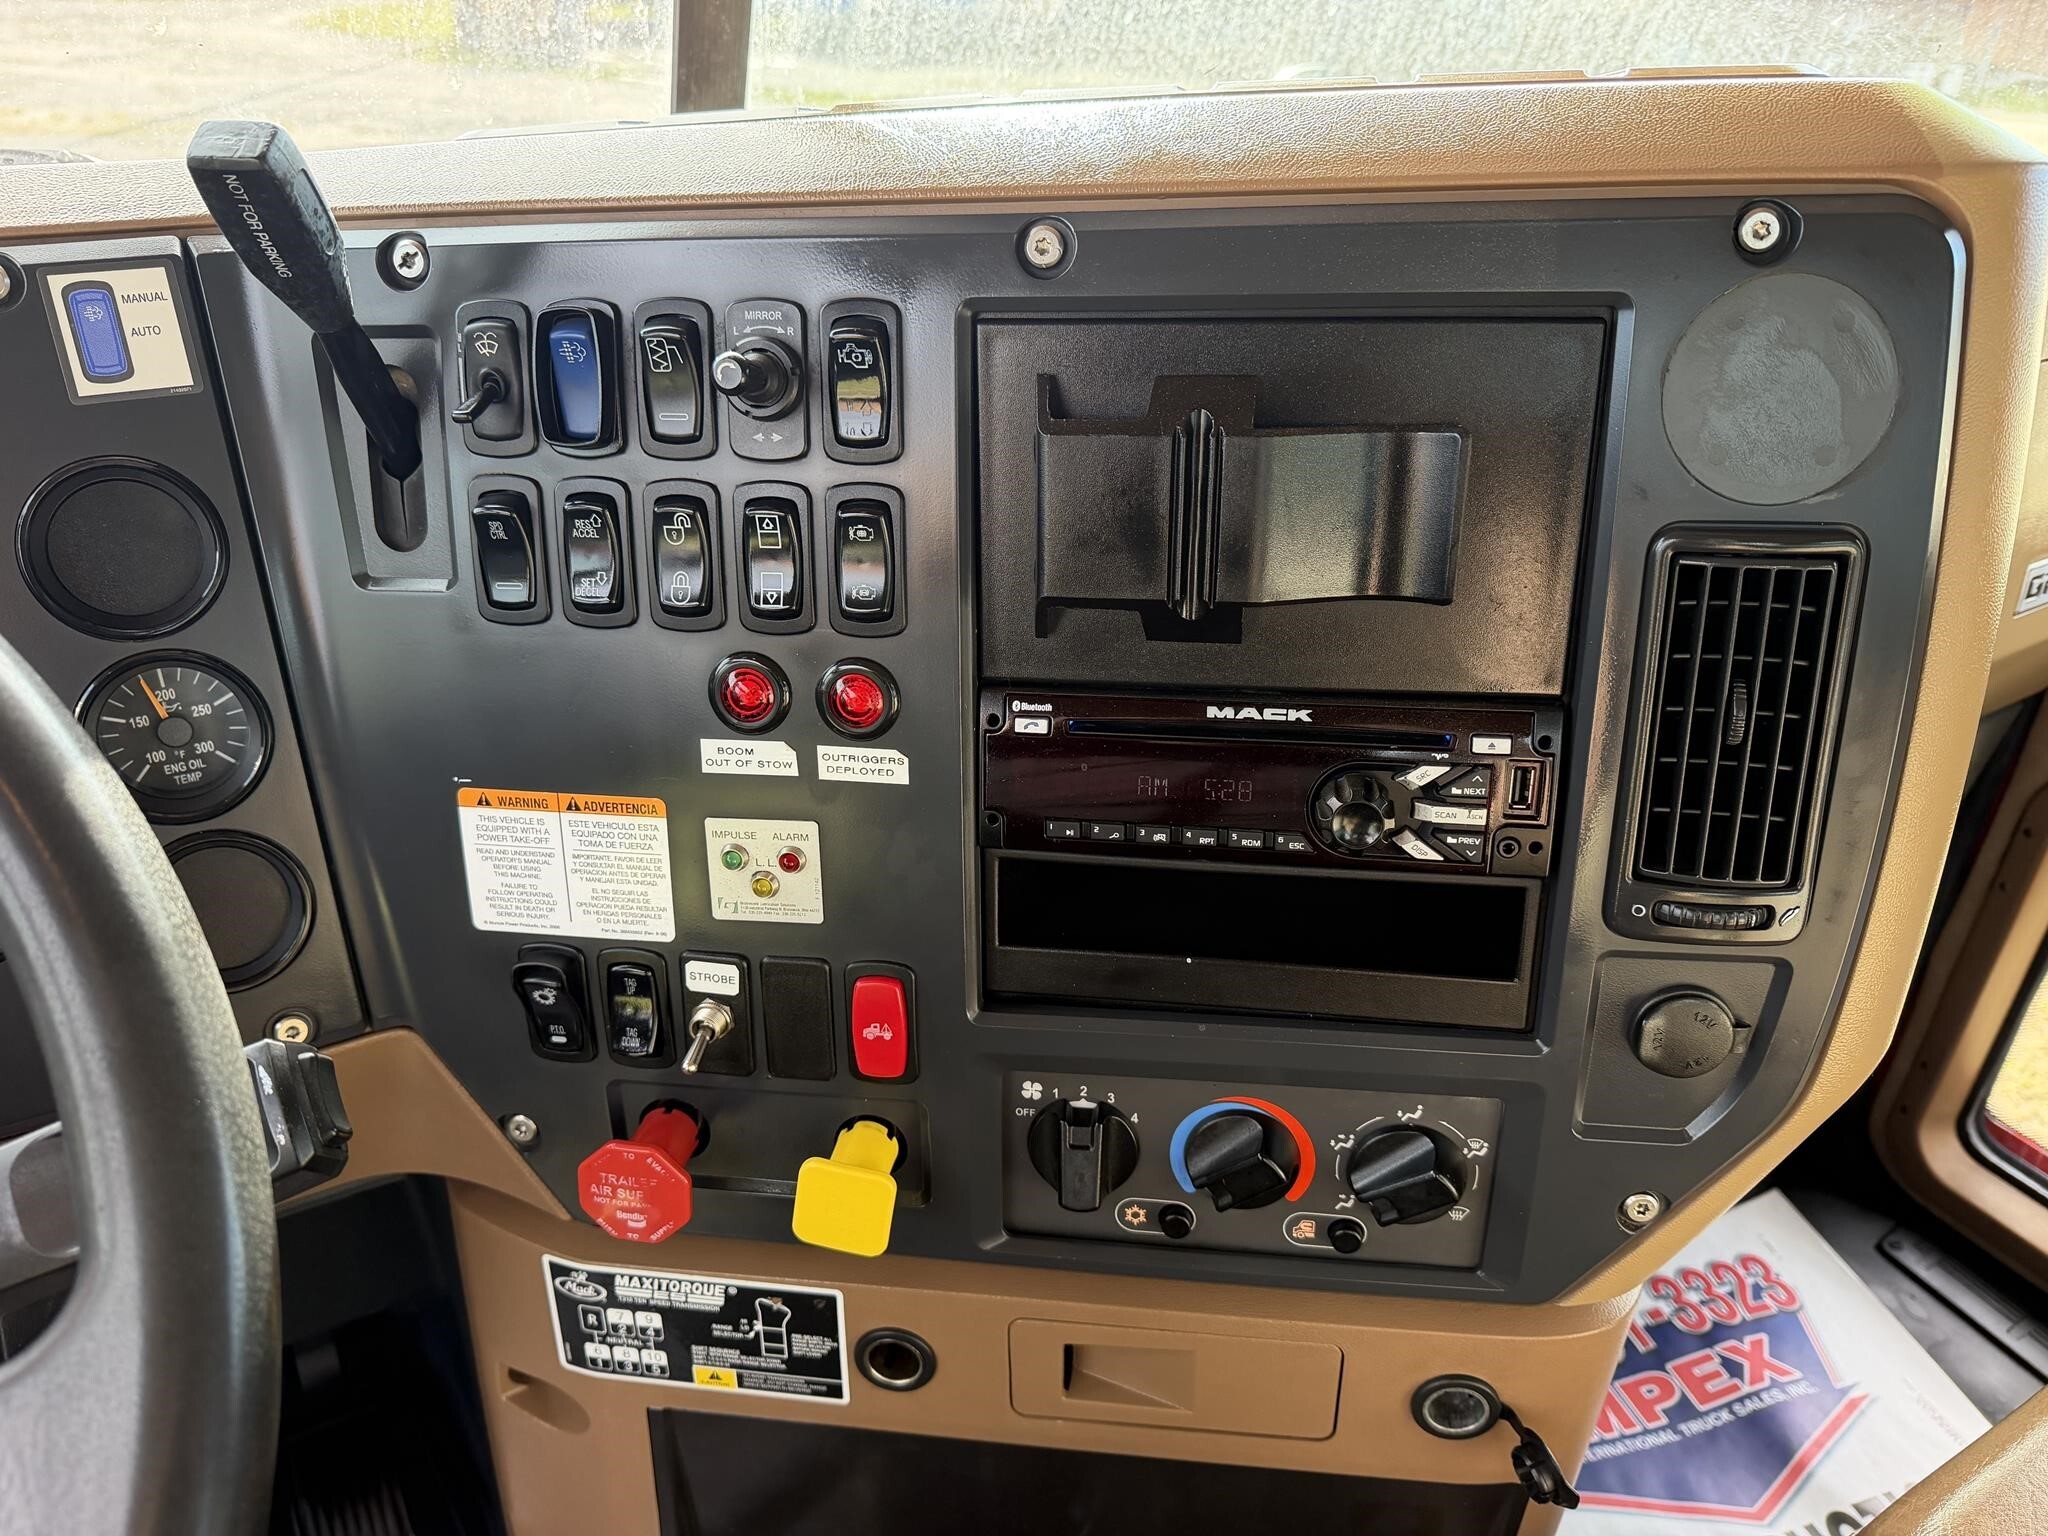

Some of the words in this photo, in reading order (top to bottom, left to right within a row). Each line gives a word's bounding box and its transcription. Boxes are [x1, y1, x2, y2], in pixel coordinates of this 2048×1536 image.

[222, 174, 249, 202] NOT
[238, 204, 263, 230] FOR
[253, 232, 292, 278] PARKING
[121, 291, 168, 304] MANUAL
[745, 310, 782, 320] MIRROR
[131, 325, 161, 337] AUTO
[733, 327, 739, 335] L
[787, 327, 794, 335] R
[488, 521, 503, 531] SPD
[490, 530, 508, 540] CTRL
[572, 528, 600, 538] ACCEL
[581, 578, 596, 588] SET
[575, 587, 601, 597] DECEL
[155, 688, 176, 702] 200
[191, 703, 212, 718] 250
[1020, 702, 1052, 712] Bluetooth
[1206, 705, 1313, 722] MACK
[129, 715, 150, 729] 150
[146, 750, 166, 764] 100
[194, 740, 215, 754] 300
[717, 747, 754, 756] BOOM
[705, 758, 730, 767] OUT
[735, 760, 752, 768] OF
[757, 760, 793, 769] STOW
[822, 753, 905, 766] OUTRIGGERS
[163, 763, 187, 775] ENG
[189, 759, 207, 770] OIL
[826, 765, 895, 777] DEPLOYED
[174, 771, 203, 785] TEMP
[1415, 770, 1431, 783] SRC
[1463, 787, 1486, 795] NEXT
[497, 796, 549, 809] WARNING
[583, 801, 658, 815] ADVERTENCIA
[478, 815, 497, 823] THIS
[499, 816, 535, 825] VEHICLE
[537, 818, 545, 826] IS
[1434, 811, 1457, 819] SCAN
[476, 824, 518, 833] EQUIPPED
[520, 826, 542, 835] WITH
[544, 828, 551, 836] A
[568, 820, 590, 828] ESTE
[592, 821, 635, 830] VEHICULO
[638, 824, 659, 832] ESTA
[477, 833, 508, 842] POWER
[571, 829, 615, 839] EQUIPADO
[617, 832, 637, 840] CON
[639, 834, 658, 842] UNA
[711, 830, 757, 840] IMPULSE
[772, 832, 810, 842] ALARM
[1199, 837, 1215, 845] RPT
[578, 839, 603, 848] TOMA
[605, 841, 617, 849] DE
[619, 842, 654, 851] FUERZA
[1288, 842, 1305, 850] ESC
[476, 847, 494, 855] READ
[495, 848, 510, 856] AND
[511, 849, 556, 858] UNDERSTAND
[1411, 844, 1429, 858] DISP
[494, 870, 509, 878] THIS
[520, 865, 542, 873] USING
[488, 888, 515, 896] FOLLOW
[516, 890, 553, 899] OPERATING
[486, 896, 533, 905] INSTRUCTIONS
[534, 898, 558, 906] COULD
[496, 911, 525, 919] SERIOUS
[624, 977, 637, 986] TAG
[689, 971, 736, 985] STROBE
[627, 986, 635, 995] UP
[626, 1027, 638, 1036] TAG
[621, 1036, 641, 1047] DOWN
[1053, 1087, 1059, 1098] 1
[1080, 1086, 1088, 1097] 2
[1107, 1092, 1115, 1103] 3
[1131, 1112, 1139, 1123] 4
[1015, 1107, 1036, 1117] OFF
[590, 1183, 612, 1197] AIR
[594, 1195, 610, 1204] NOT
[613, 1274, 727, 1298] MAXITORQUE
[586, 1313, 598, 1327] R
[616, 1311, 624, 1322] 7
[645, 1314, 653, 1325] 9
[1677, 1407, 1736, 1438] TRUCK
